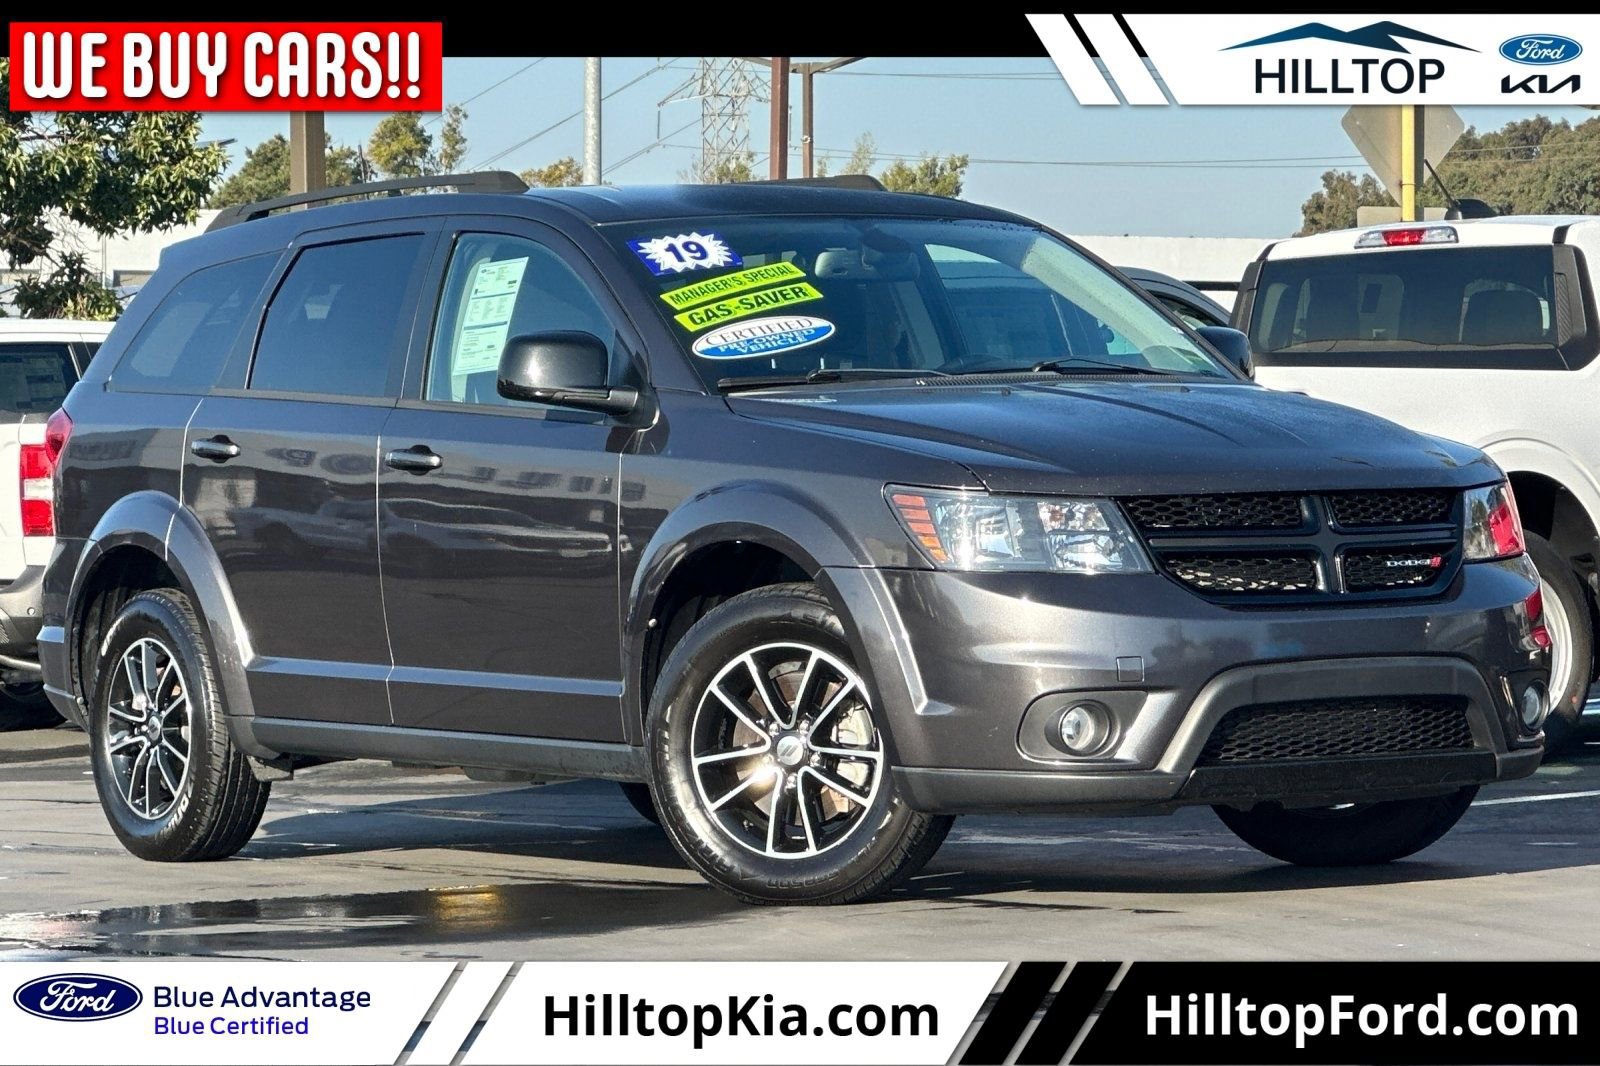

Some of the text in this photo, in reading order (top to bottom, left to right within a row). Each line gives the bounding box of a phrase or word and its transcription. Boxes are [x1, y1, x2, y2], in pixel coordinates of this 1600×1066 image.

[664, 240, 709, 263] 19
[668, 264, 795, 305] MANAGER'S SPECIAL
[705, 318, 813, 346] CERTIFIED
[717, 328, 816, 353] PRE-OWNED
[739, 336, 808, 354] VEHICLE
[1386, 558, 1431, 567] DODGE
